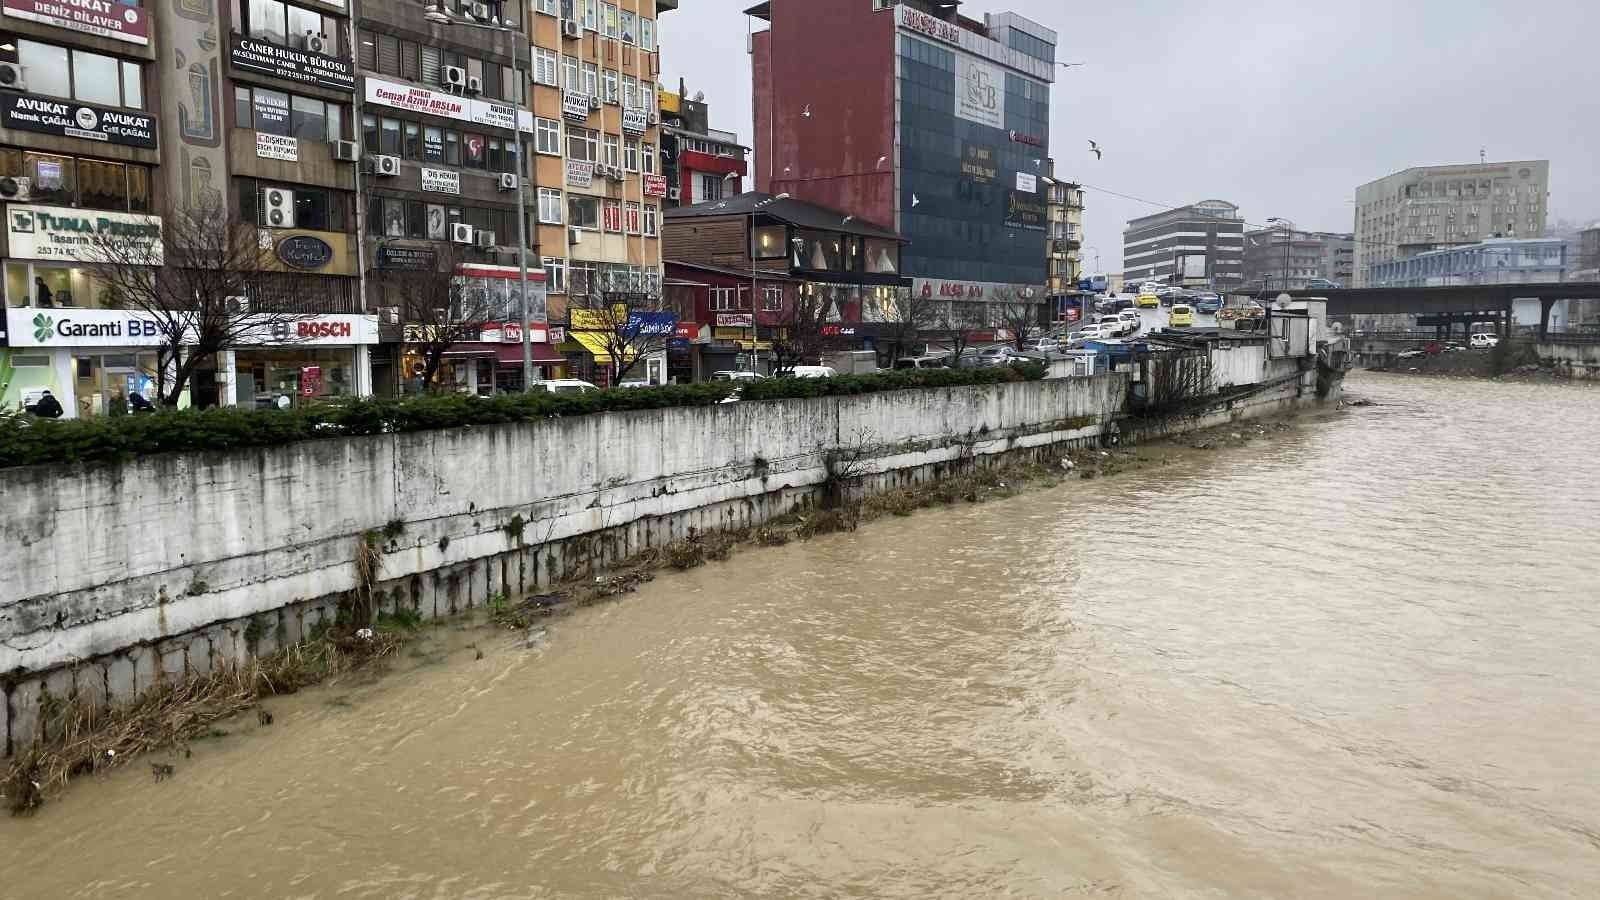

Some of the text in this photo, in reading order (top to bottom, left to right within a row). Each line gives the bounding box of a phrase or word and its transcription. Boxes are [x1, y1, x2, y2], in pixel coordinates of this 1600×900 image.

[34, 2, 71, 18] DENİZ
[73, 10, 123, 30] DİLAVER
[240, 40, 346, 72] CANER HUKUK BÜROSU
[16, 98, 69, 115] AVUKAT
[376, 88, 406, 102] Cemal
[429, 99, 462, 113] ARSLAN
[565, 95, 588, 108] AVUKAT
[10, 110, 75, 127] Namık ÇAĞALI
[102, 112, 150, 129] AVUKAT
[624, 113, 646, 124] AVUKAT
[120, 127, 151, 139] ÇAĞALI
[48, 233, 89, 245] Tasarım
[57, 318, 122, 337] Garanti
[297, 321, 351, 337] BOSCH
